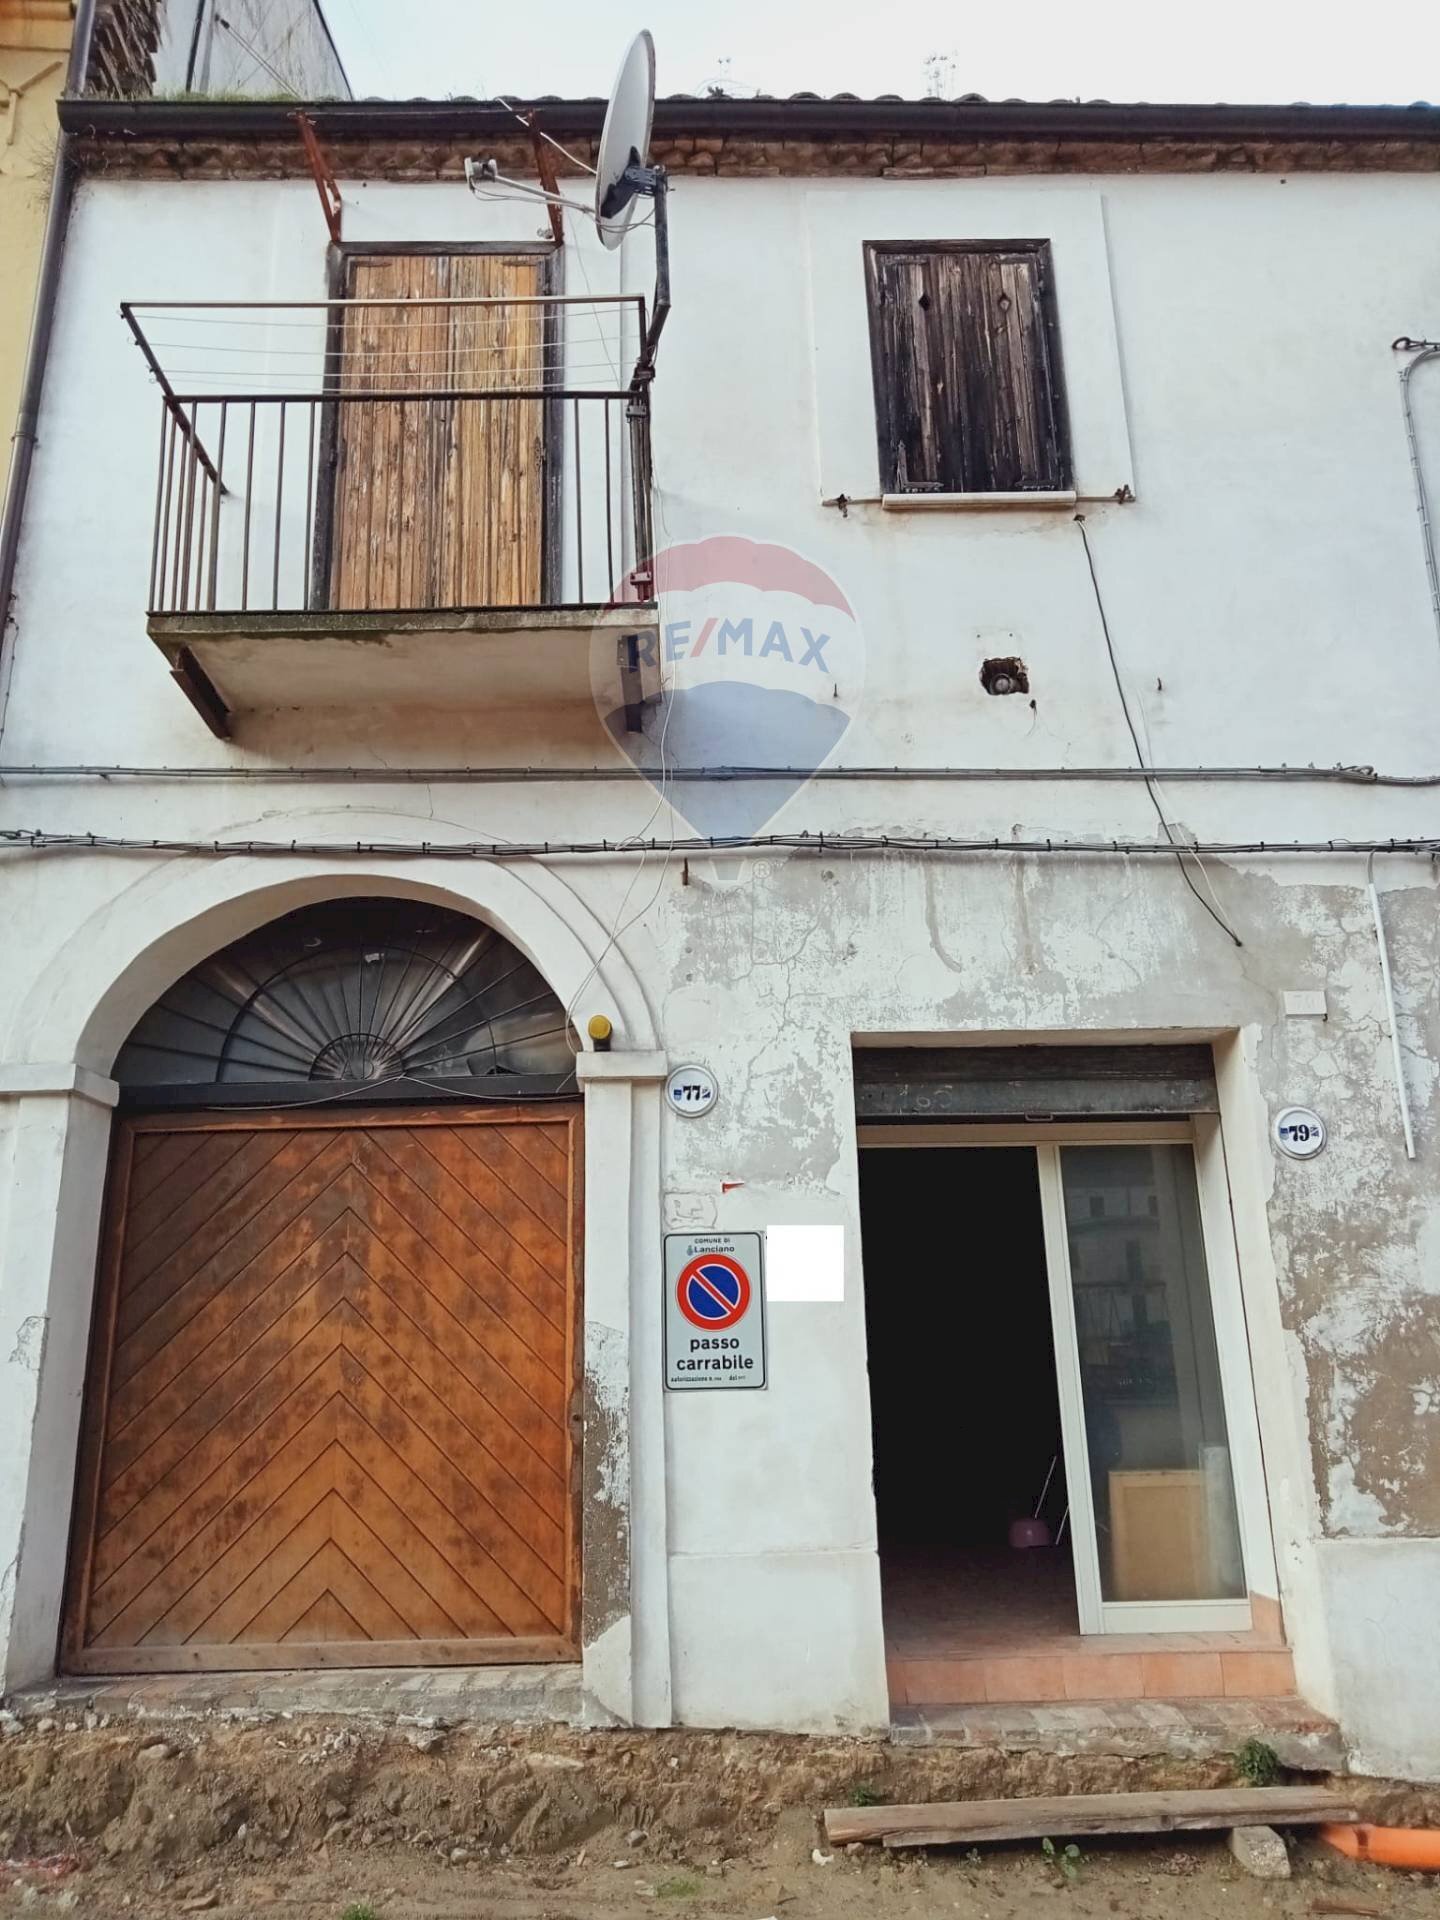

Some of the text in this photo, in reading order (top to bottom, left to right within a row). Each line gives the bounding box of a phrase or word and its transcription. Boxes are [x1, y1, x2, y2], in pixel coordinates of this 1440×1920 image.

[683, 1085, 701, 1101] 77
[1288, 1124, 1310, 1142] 79
[694, 1245, 735, 1253] Lanciano
[690, 1338, 740, 1353] passo
[676, 1354, 754, 1371] carrabile
